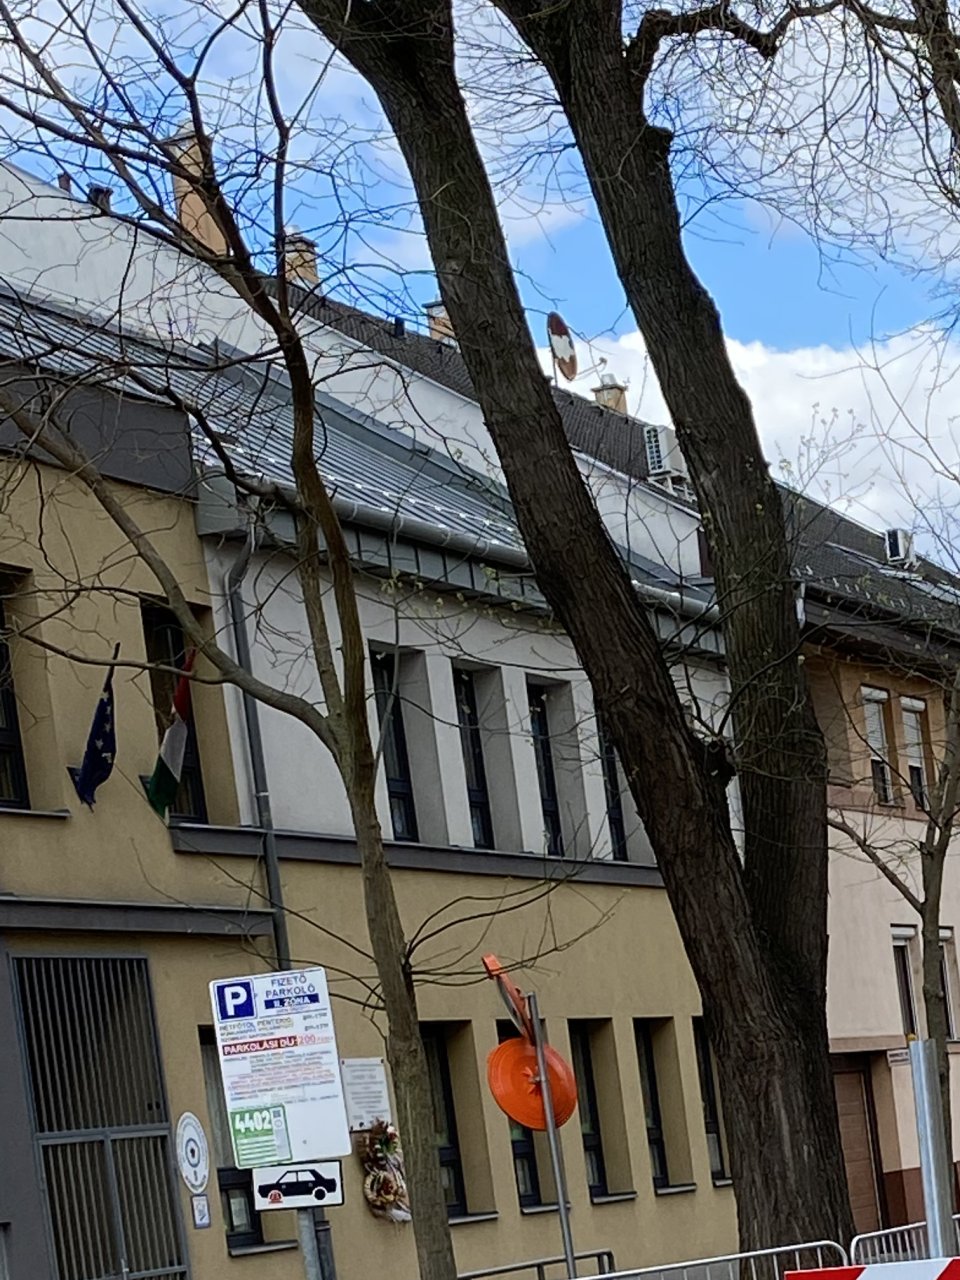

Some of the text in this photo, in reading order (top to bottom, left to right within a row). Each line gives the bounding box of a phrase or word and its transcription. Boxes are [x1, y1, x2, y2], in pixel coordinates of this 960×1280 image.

[265, 983, 316, 998] PARKOLÓ
[224, 985, 247, 1016] P
[284, 996, 310, 1007] ZÓNA
[224, 1039, 279, 1055] PARKOLÁSI
[234, 1109, 272, 1134] 4402
